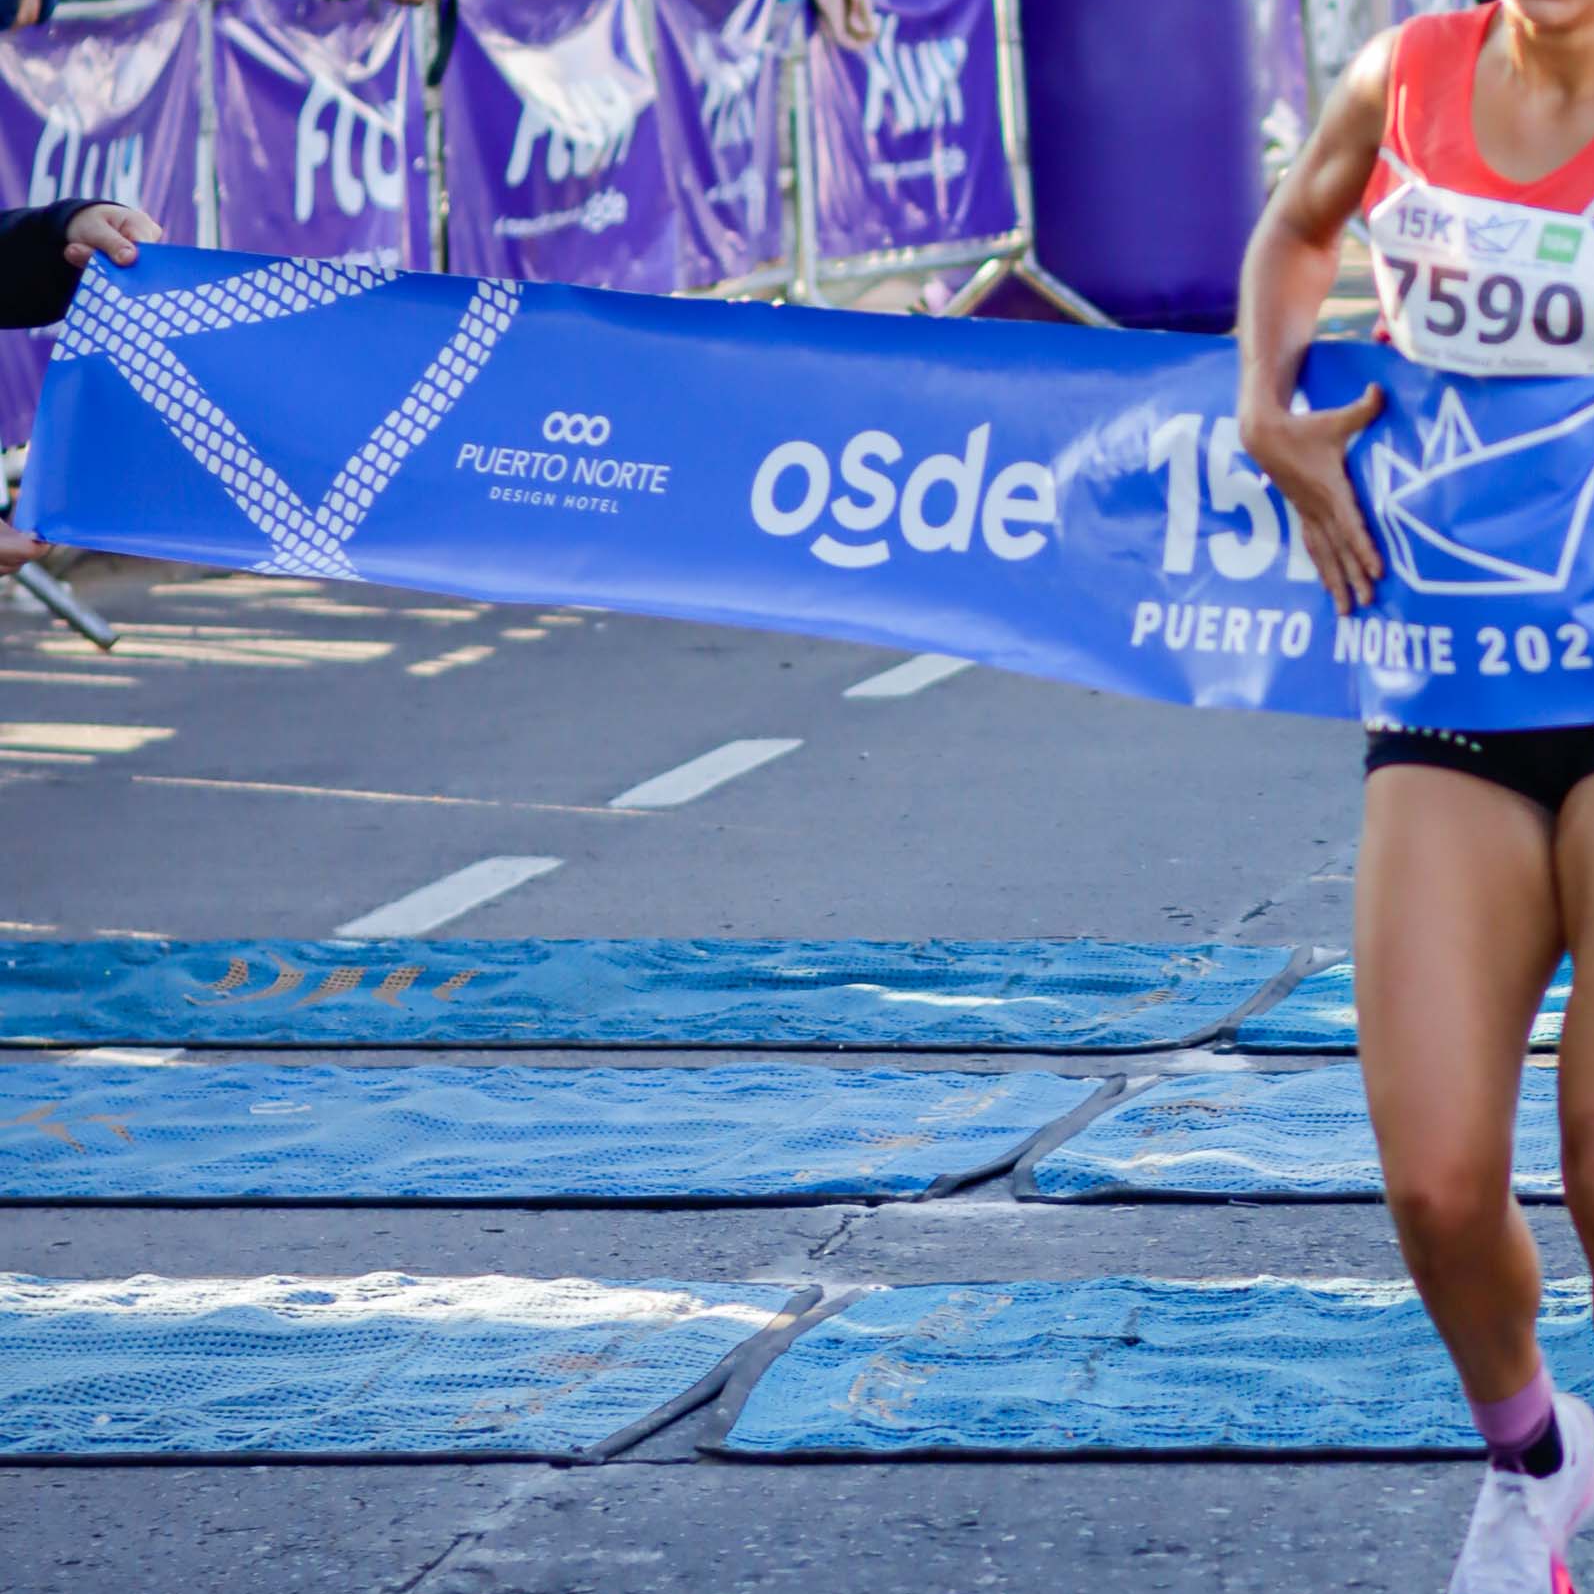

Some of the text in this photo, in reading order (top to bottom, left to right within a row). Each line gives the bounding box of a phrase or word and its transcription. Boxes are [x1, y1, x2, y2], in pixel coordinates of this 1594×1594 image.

[1397, 208, 1453, 243] 15K
[1384, 255, 1584, 346] 7590
[456, 444, 671, 494] PUERTO NORTE
[489, 486, 619, 514] DESIGN HOTEL
[751, 423, 1057, 562] osde
[1131, 602, 1312, 658] PUERTO
[1334, 616, 1455, 676] NORTE
